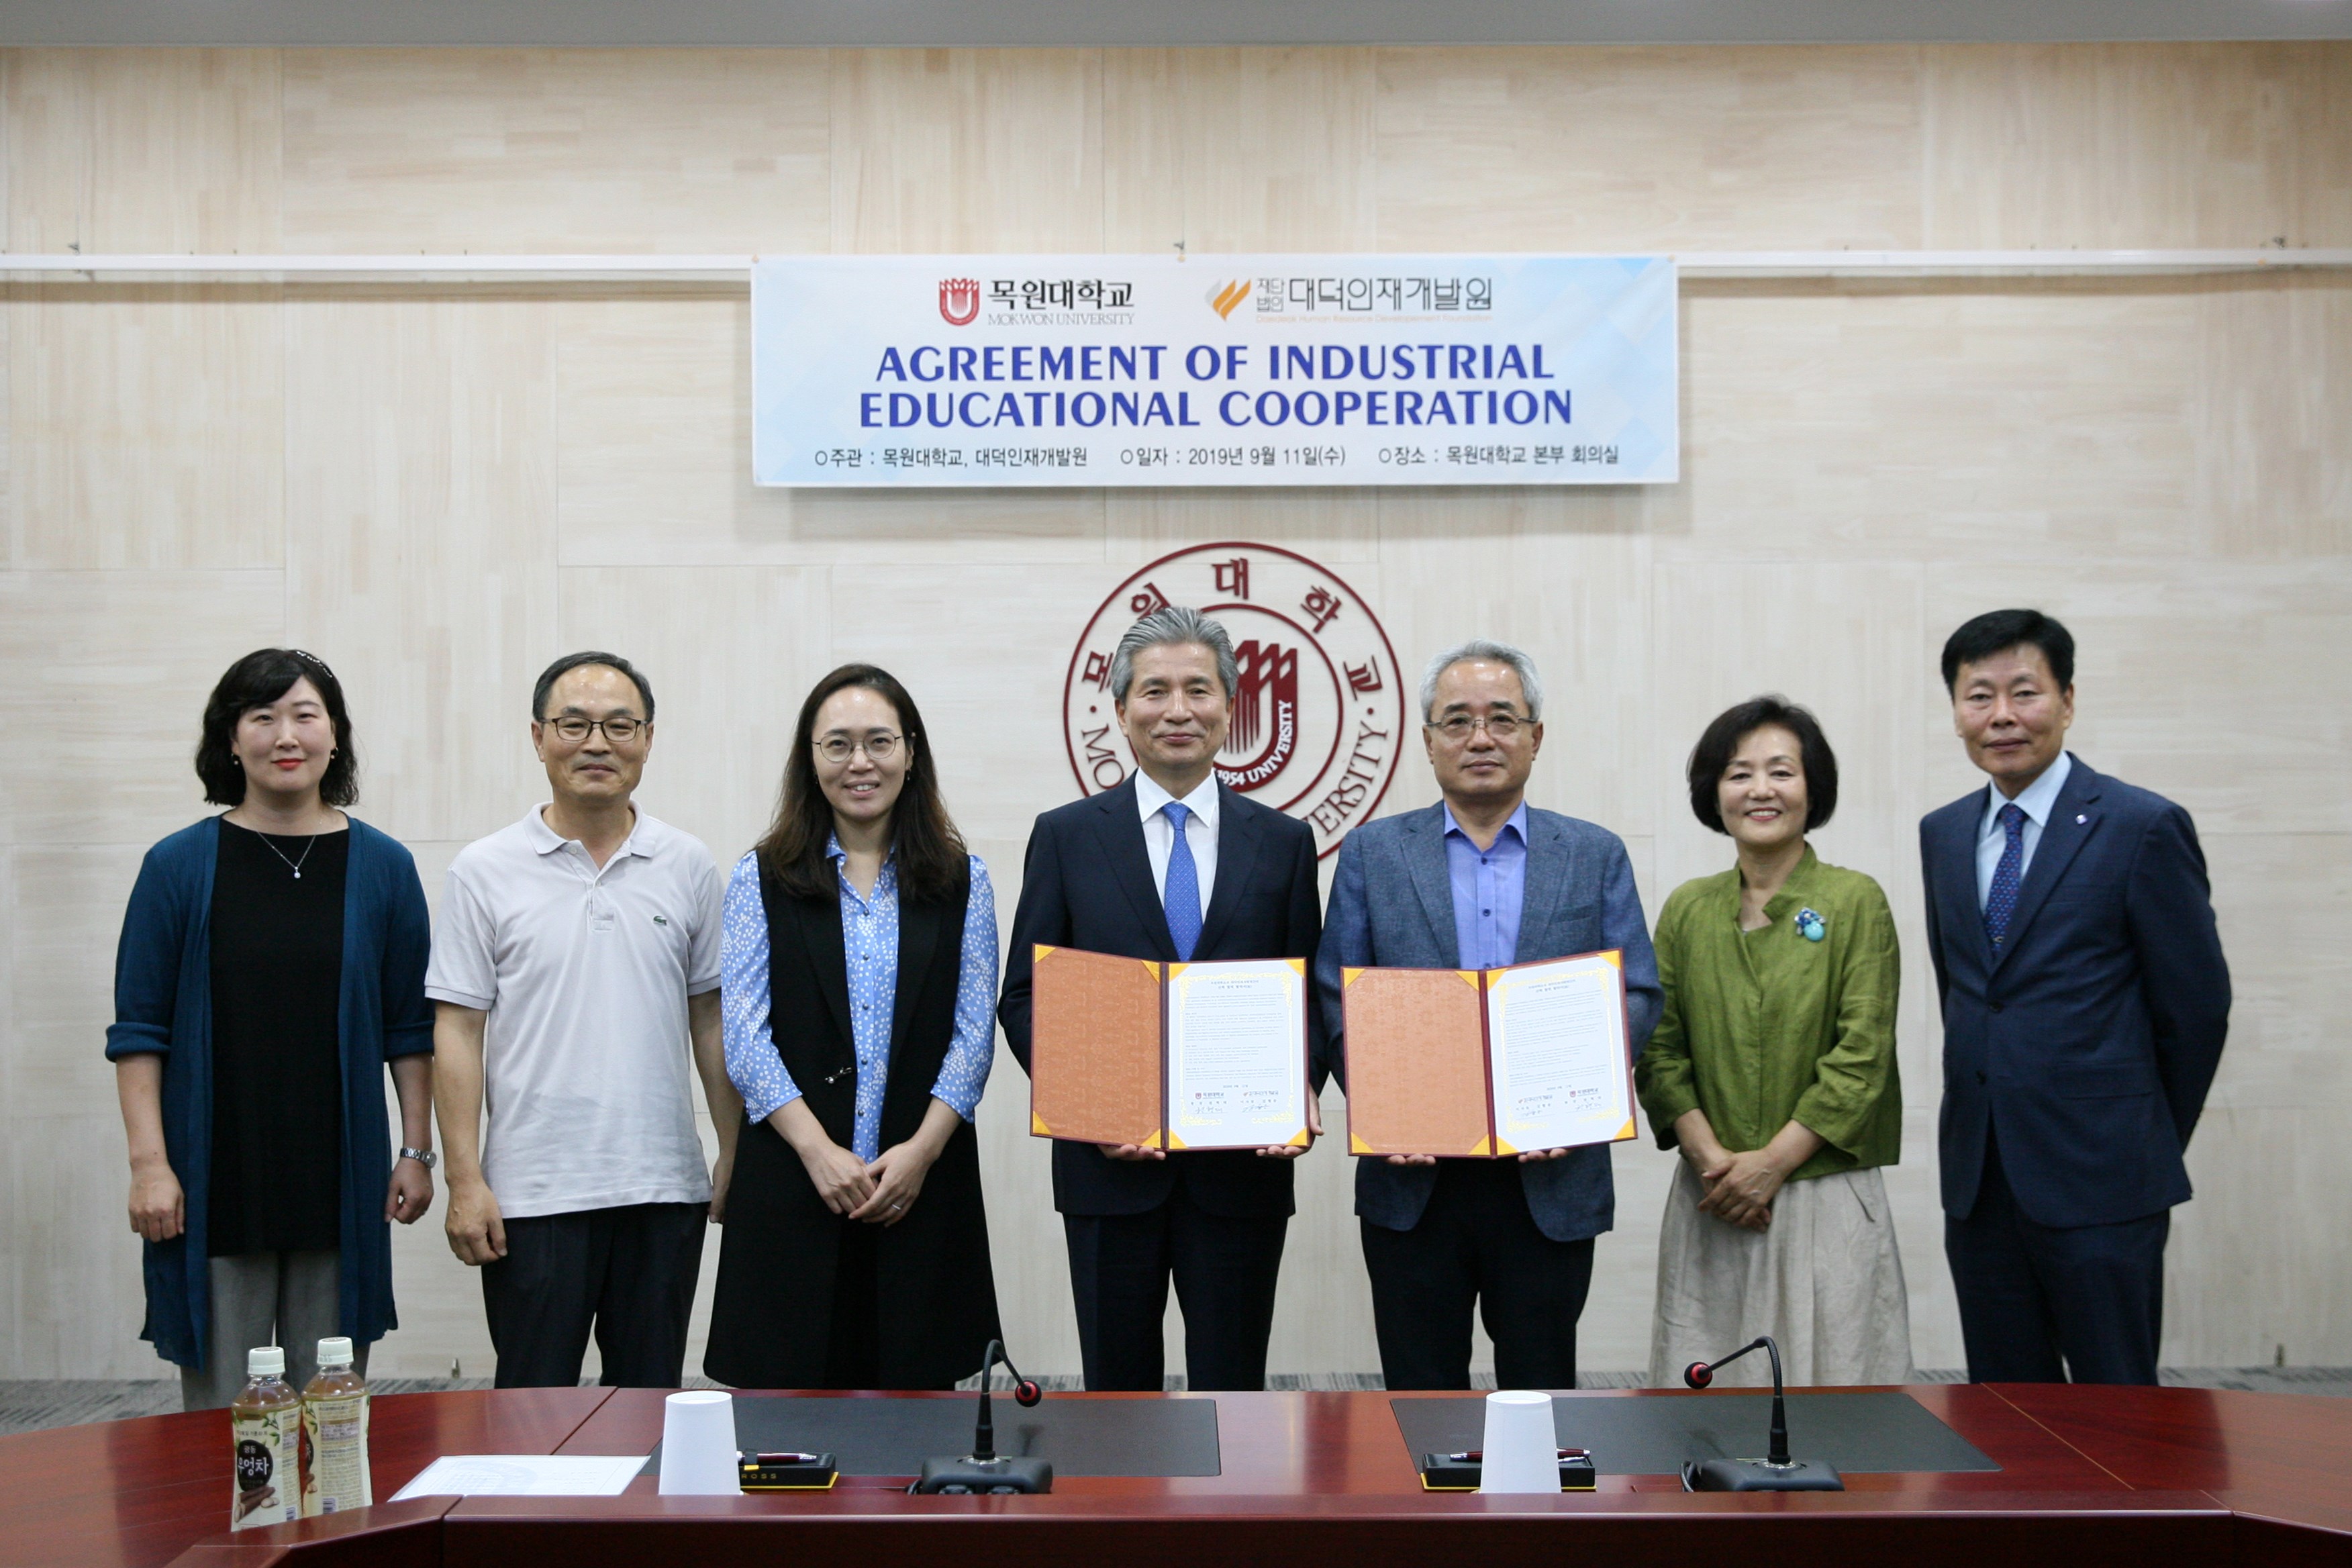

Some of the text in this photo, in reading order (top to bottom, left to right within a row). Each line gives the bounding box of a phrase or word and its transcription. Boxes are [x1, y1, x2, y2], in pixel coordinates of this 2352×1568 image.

[987, 279, 1134, 310] 목원대학교
[1257, 277, 1285, 294] 재단
[1289, 277, 1492, 311] 대덕인재개발원
[1257, 297, 1284, 312] 법인
[987, 313, 1134, 326] MOKWON UNIVERSITY
[876, 344, 1554, 381] AGREEMENT OF INDUSTRIAL
[861, 390, 1571, 428] EDUCATIONAL COOPERATION
[883, 448, 968, 468] 목원대학교,
[975, 447, 1087, 467] 대덕인재개발원
[1189, 448, 1243, 466] 2019년
[1250, 446, 1275, 466] 9월
[1284, 446, 1346, 466] 11일(수)
[1447, 446, 1527, 464] 목원대학교
[1533, 446, 1565, 464] 본부
[1571, 446, 1618, 464] 회의실
[1246, 699, 1293, 783] UNIVERSITY
[238, 1457, 269, 1476] 우엉차
